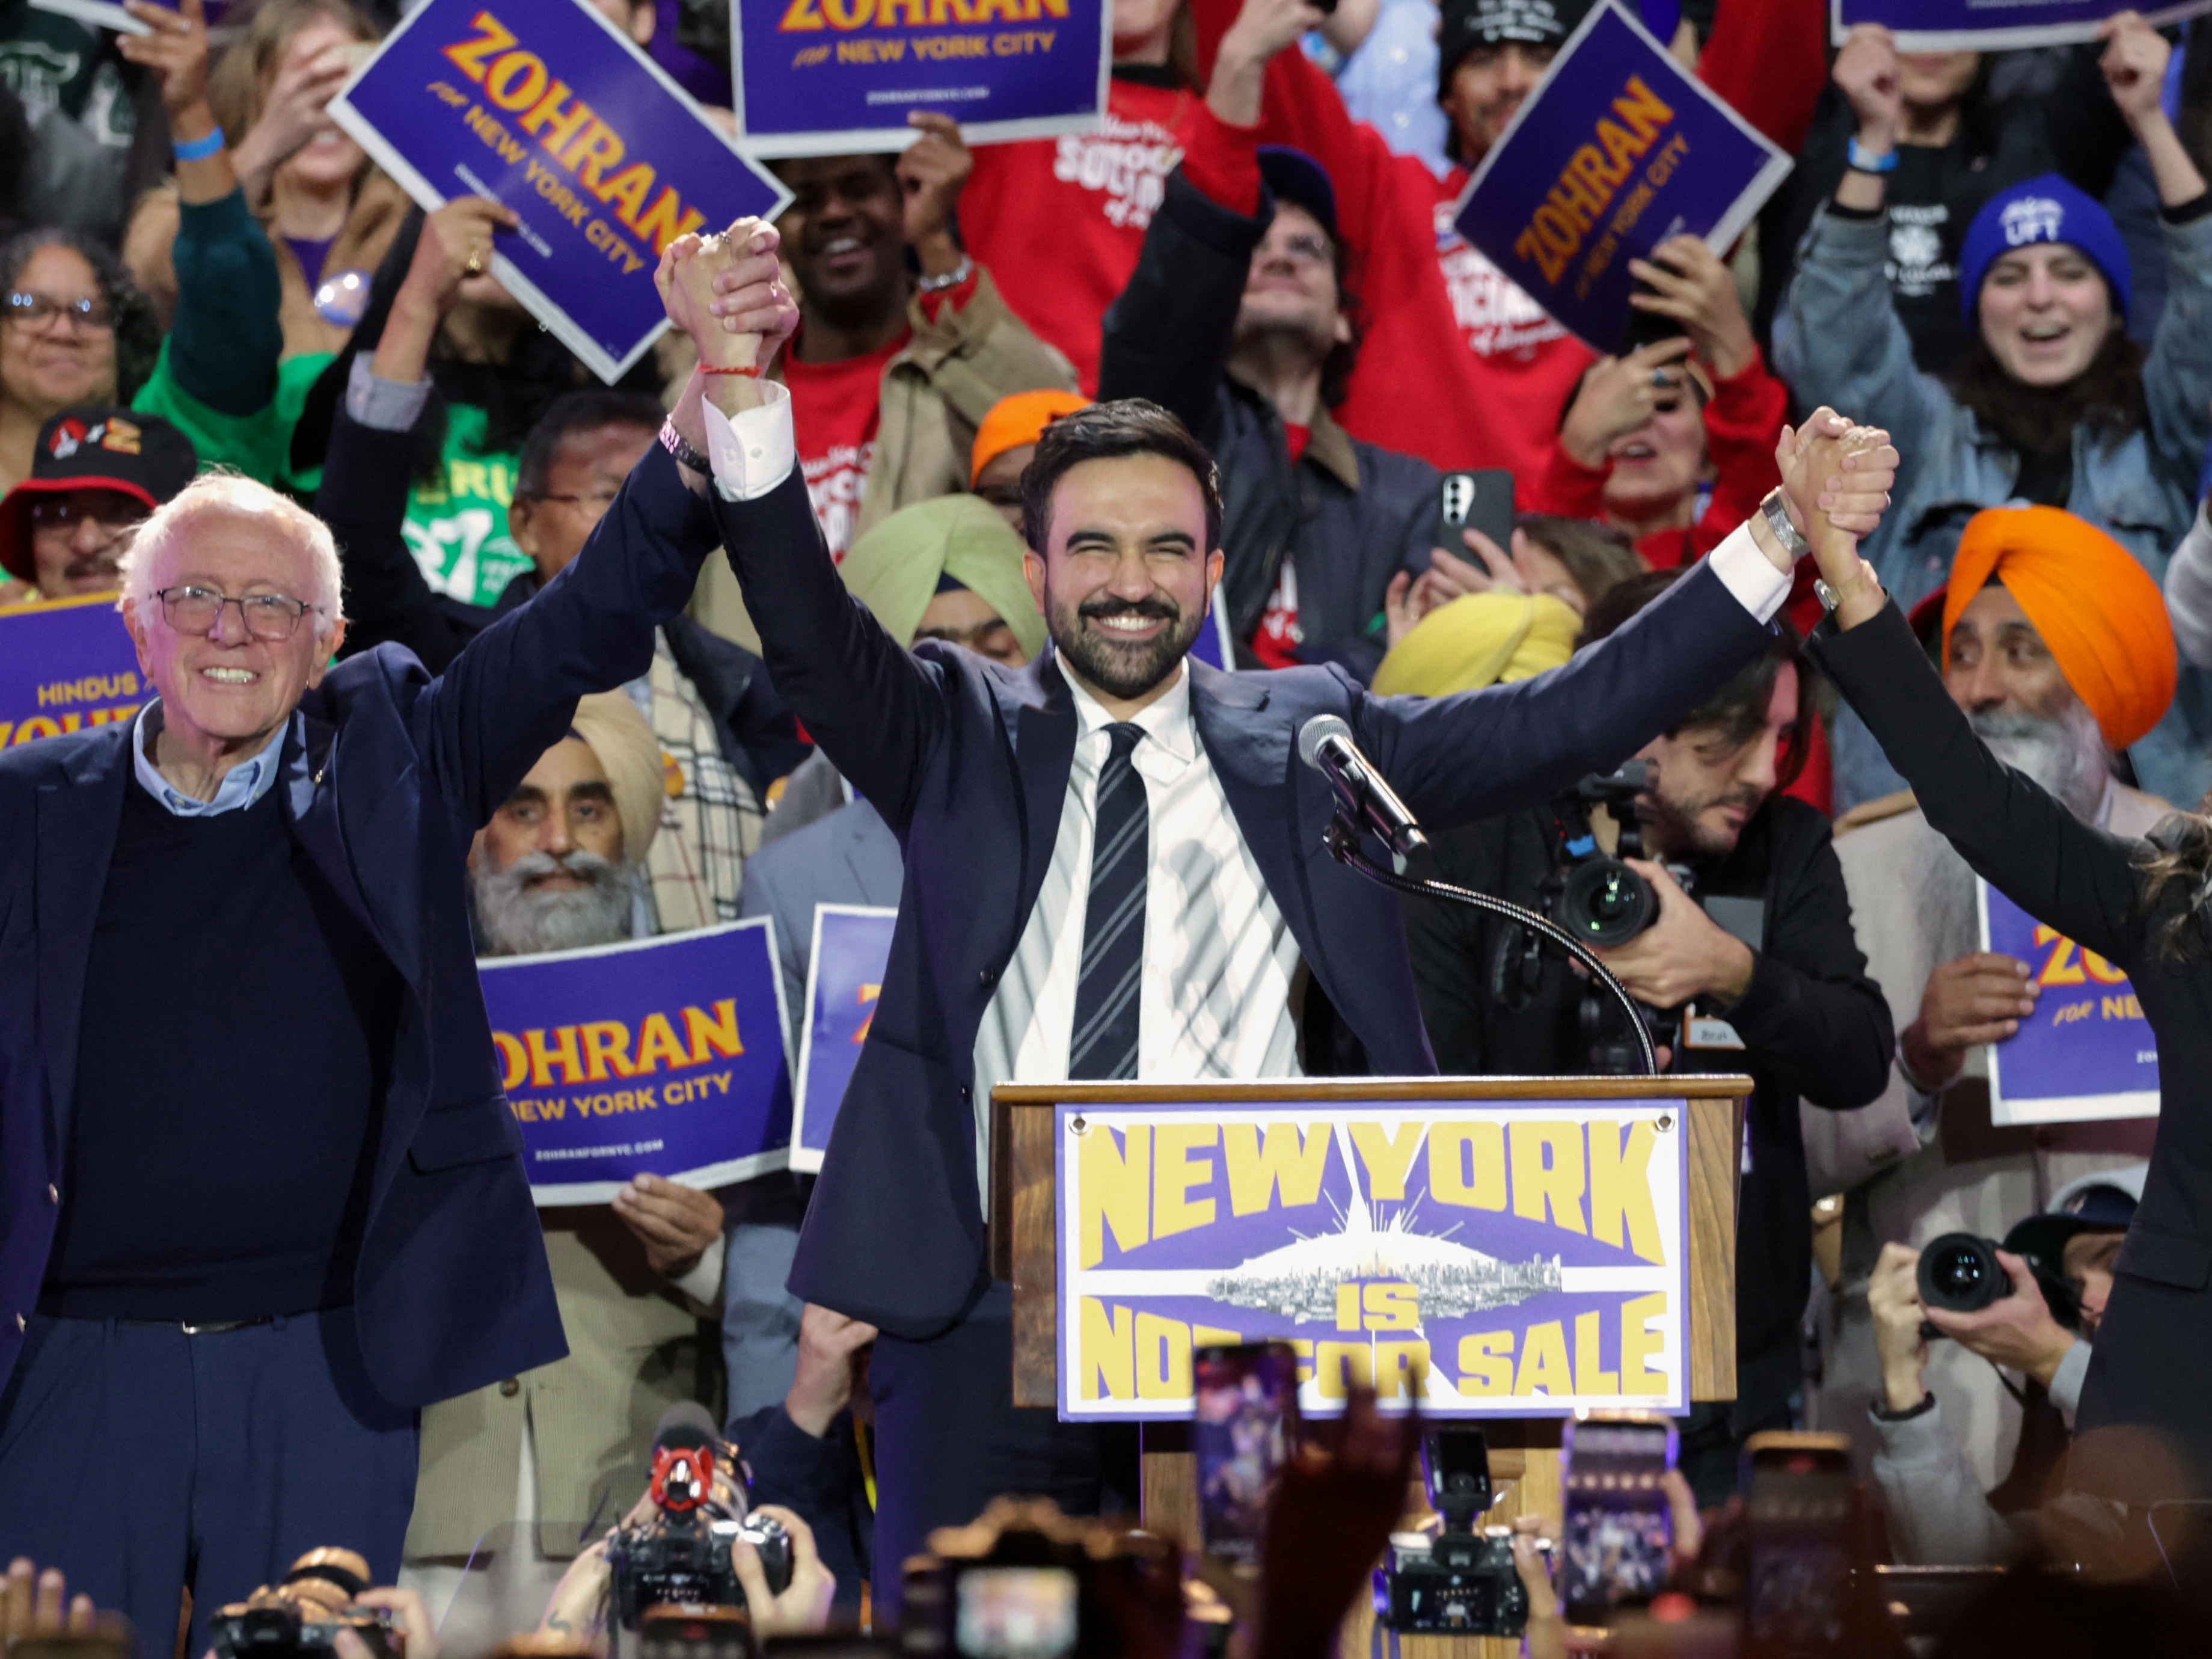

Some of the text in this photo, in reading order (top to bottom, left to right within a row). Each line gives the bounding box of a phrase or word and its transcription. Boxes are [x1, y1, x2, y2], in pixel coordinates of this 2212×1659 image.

[836, 39, 906, 64] NEW
[911, 35, 990, 61] YORK
[993, 31, 1056, 57] CITY
[441, 10, 706, 259] ZOHRAN
[1514, 75, 1675, 287] ZOHRAN
[464, 104, 529, 165] NEW
[524, 158, 592, 228] YORK
[584, 218, 646, 275] CITY
[37, 670, 139, 708] HINDUS
[572, 1087, 658, 1118] YORK
[663, 1072, 733, 1105] CITY
[1079, 1120, 1665, 1271] NEW YORK
[1336, 1283, 1419, 1332] IS
[1458, 1292, 1668, 1397] SALE
